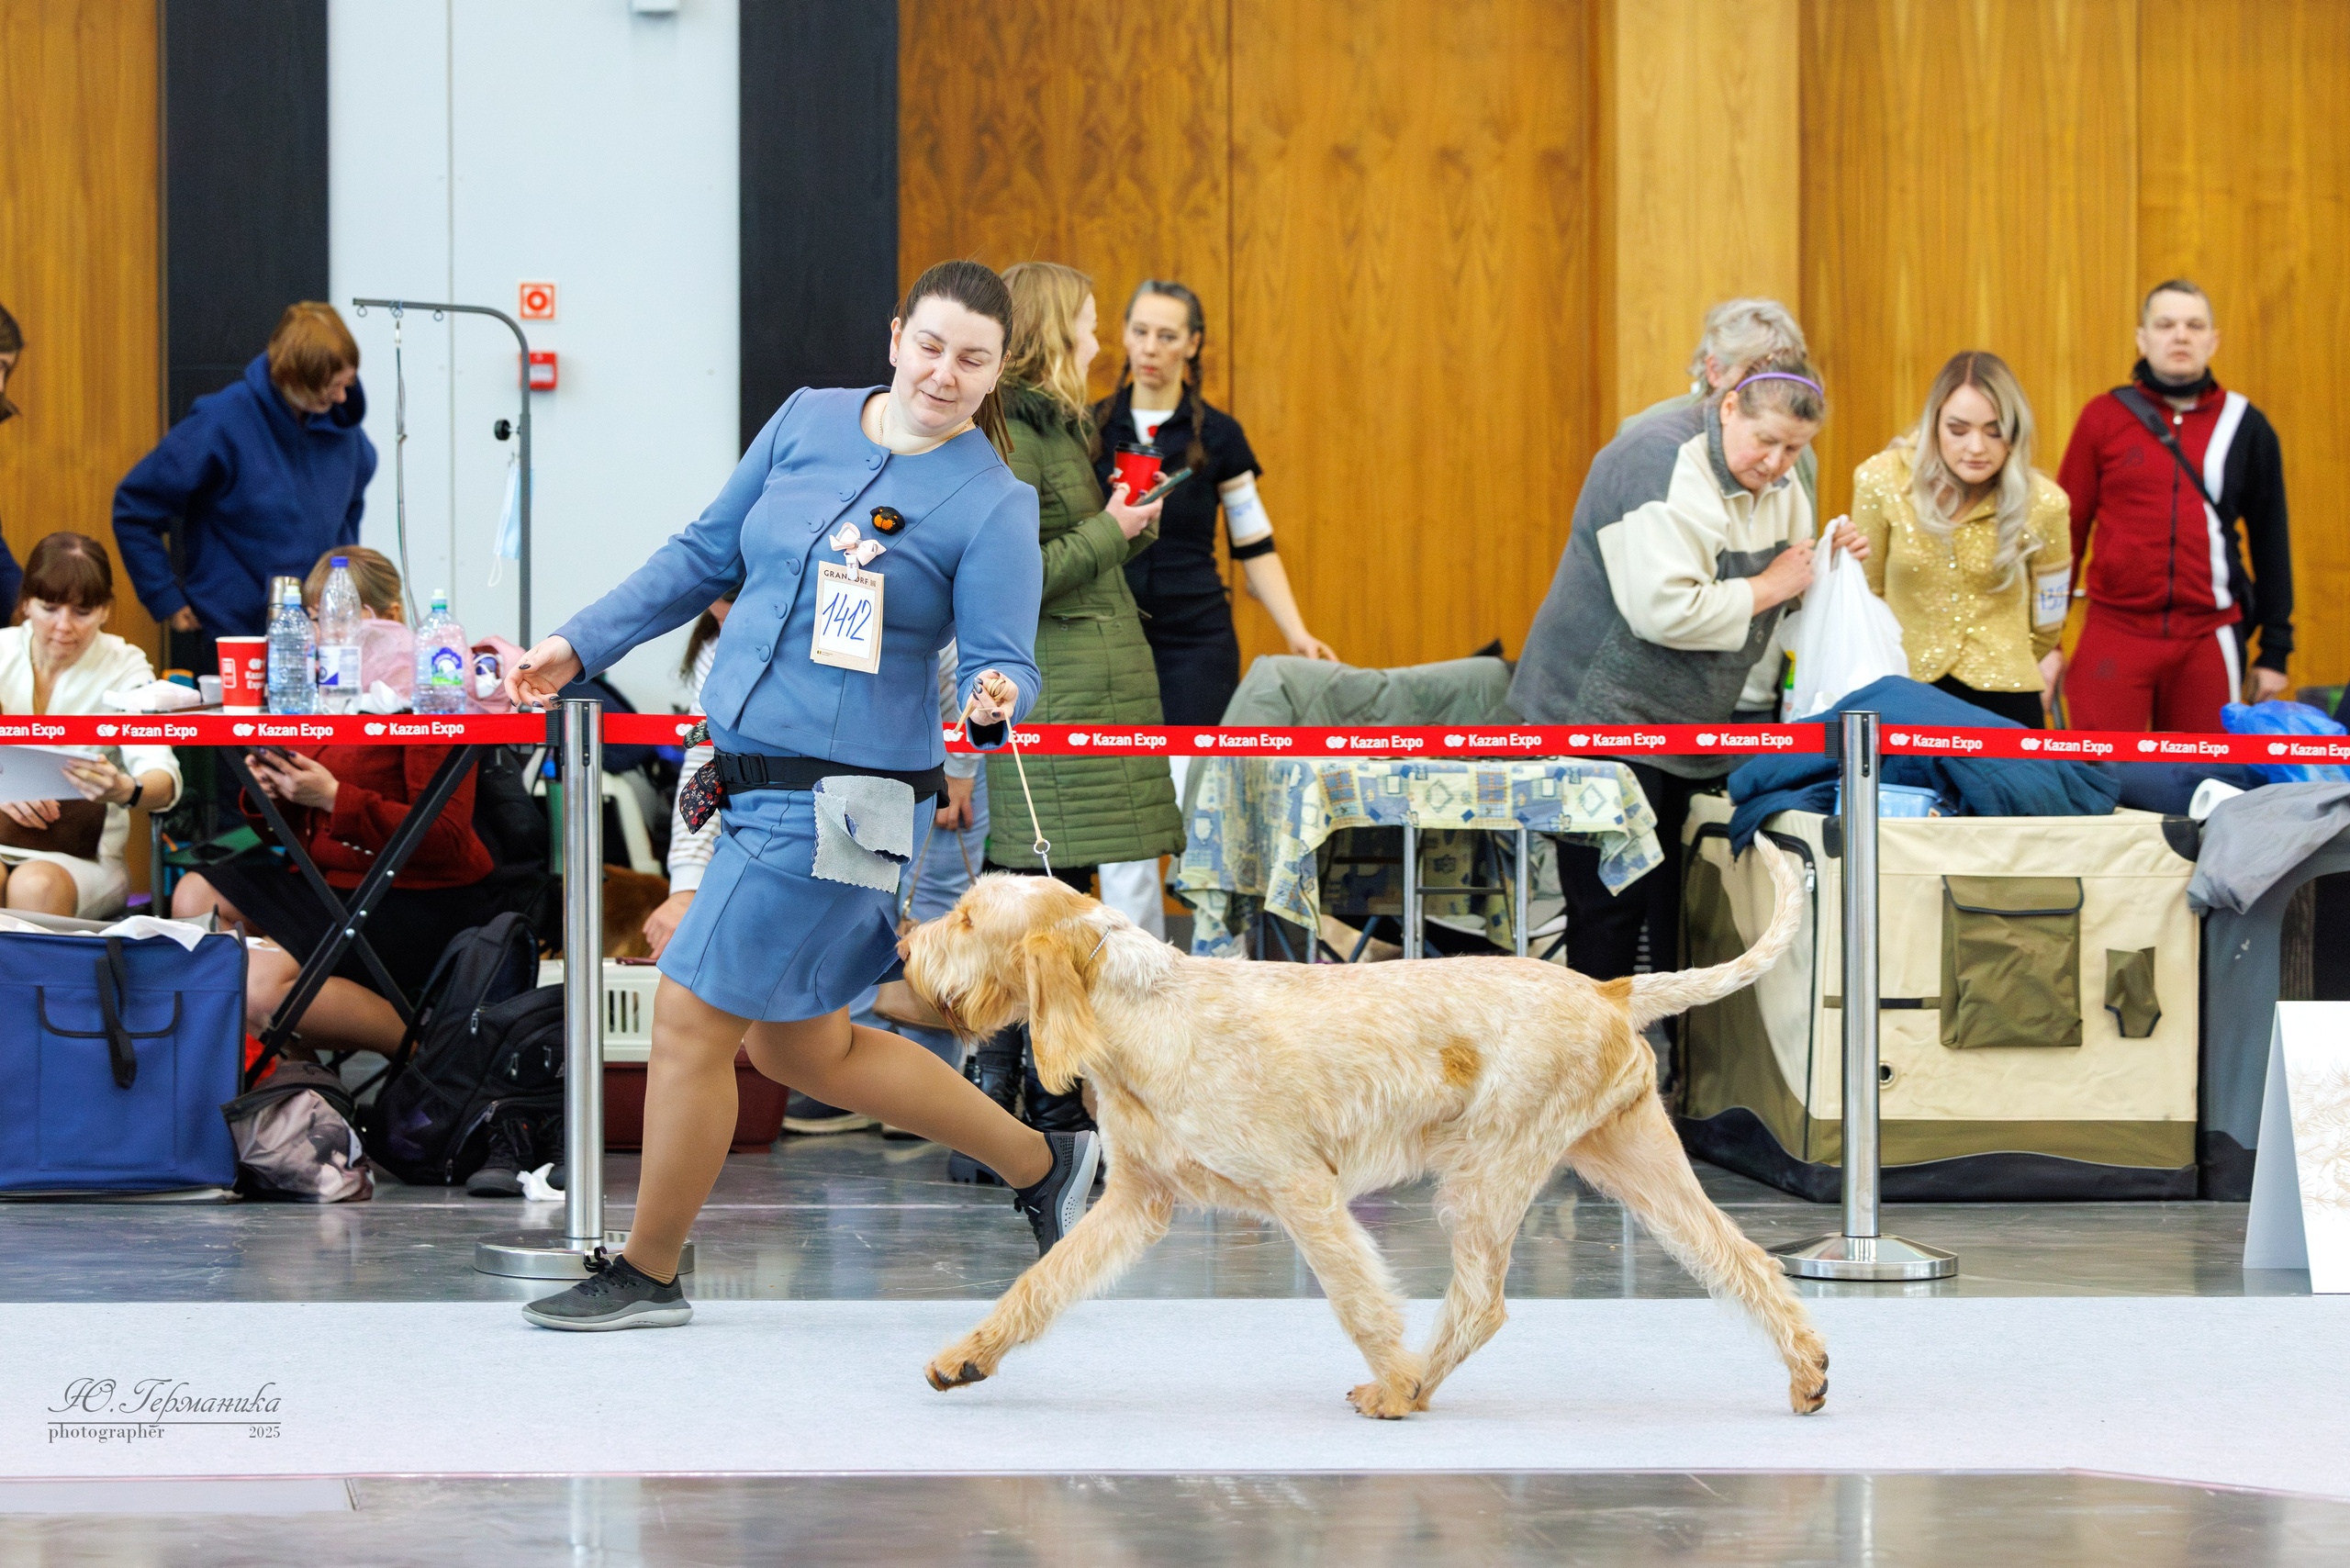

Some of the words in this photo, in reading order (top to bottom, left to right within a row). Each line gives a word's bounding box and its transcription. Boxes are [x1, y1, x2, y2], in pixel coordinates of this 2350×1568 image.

[822, 592, 872, 641] 1412
[0, 725, 30, 736] azan
[31, 722, 66, 740] Expo
[121, 723, 162, 737] Kazan
[163, 723, 198, 740] Expo
[257, 722, 298, 737] Kazan
[300, 722, 334, 740] Expo
[389, 722, 430, 736] Kazan
[431, 721, 465, 738] Expo
[1008, 730, 1041, 747] Expo
[1092, 733, 1133, 746] Kazan
[1134, 733, 1168, 750] Expo
[1218, 734, 1259, 747] Kazan
[1259, 733, 1292, 750] Expo
[1349, 735, 1390, 749] Kazan
[1391, 734, 1424, 752] Expo
[1468, 734, 1508, 747] Kazan
[1509, 733, 1542, 749] Expo
[1593, 734, 1632, 747] Kazan
[1633, 732, 1666, 749] Expo
[1720, 733, 1760, 747] Kazan
[1761, 733, 1794, 749] Expo
[1912, 734, 1951, 748] Kazan
[1952, 734, 1984, 753] Expo
[2043, 738, 2081, 753] Kazan
[2082, 739, 2113, 756] Expo
[2160, 740, 2198, 754] Kazan
[2199, 741, 2230, 757] Expo
[2289, 743, 2327, 756] Kazan
[2328, 744, 2350, 760] Exp
